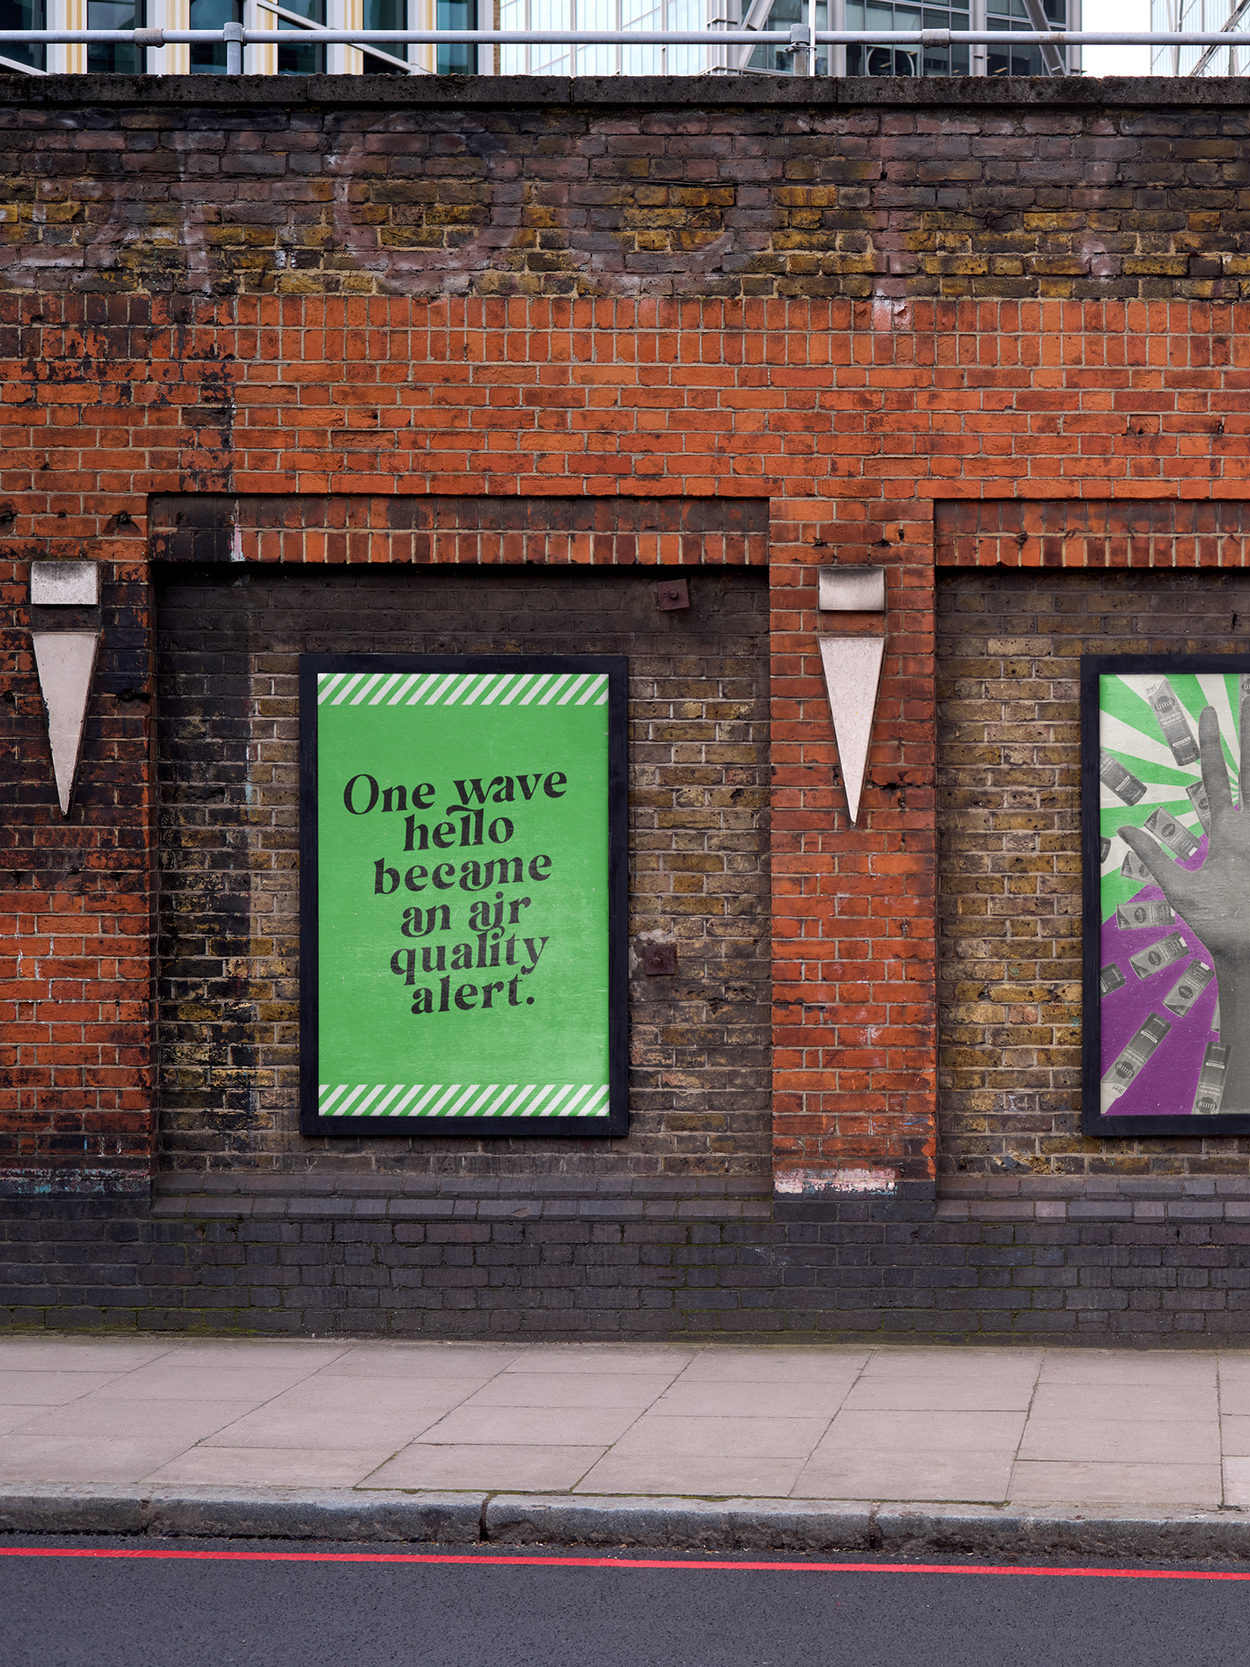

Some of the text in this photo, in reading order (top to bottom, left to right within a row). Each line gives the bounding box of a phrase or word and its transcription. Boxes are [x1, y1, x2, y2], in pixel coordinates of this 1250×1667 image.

[344, 772, 567, 815] One wave
[403, 805, 514, 851] hello
[374, 855, 551, 894] became
[401, 892, 531, 938] an air
[390, 926, 550, 985] quality
[411, 974, 535, 1014] alert.
